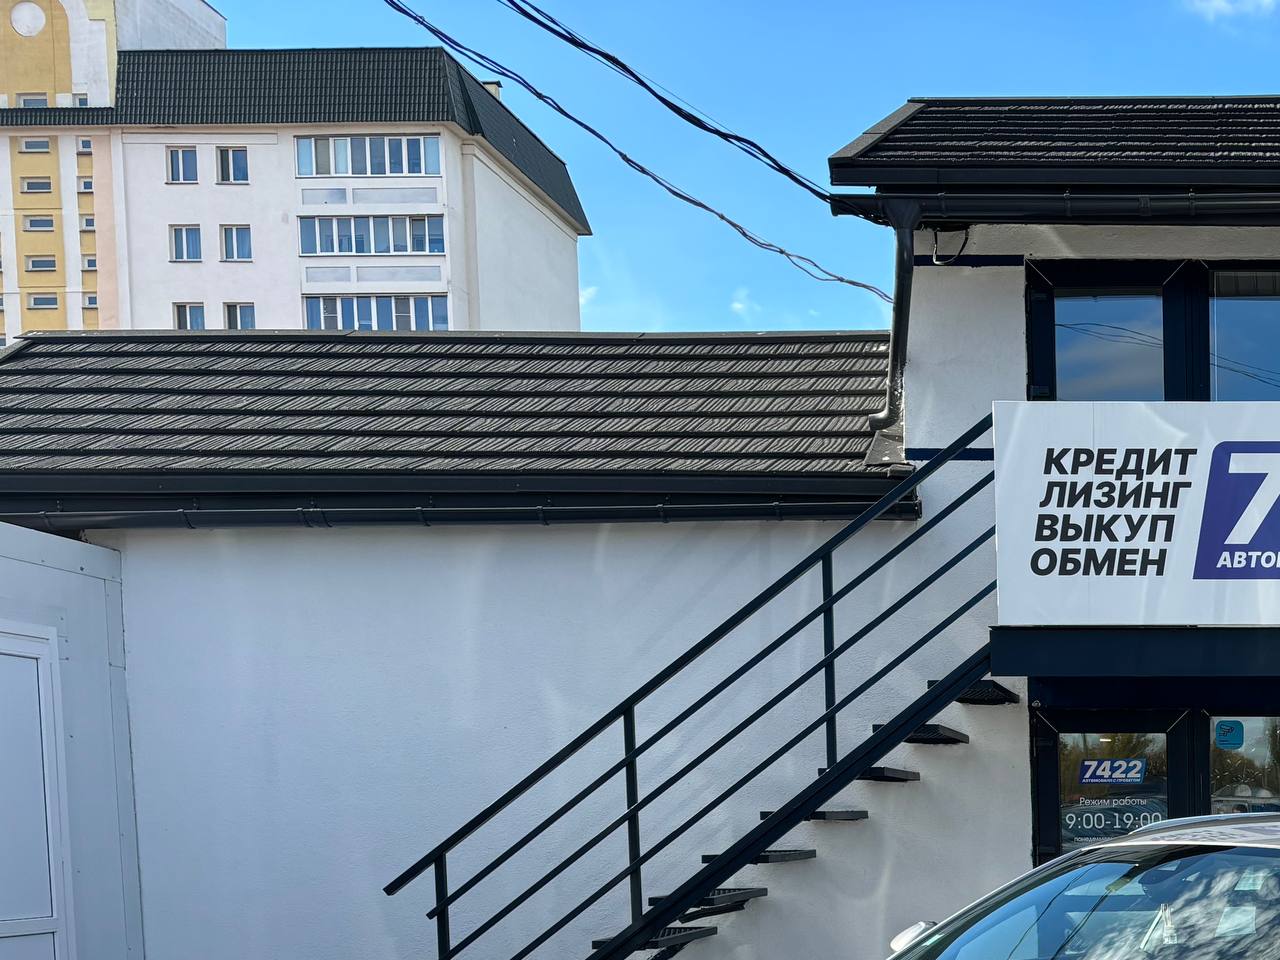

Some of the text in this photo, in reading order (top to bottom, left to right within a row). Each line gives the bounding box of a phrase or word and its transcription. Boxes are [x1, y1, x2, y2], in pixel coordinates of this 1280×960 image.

[1043, 447, 1198, 481] КРЕДИТ
[1039, 480, 1192, 508] ЛИЗИНГ
[1034, 513, 1176, 543] ВЫКУП
[1030, 547, 1168, 577] ОБМЕН
[1084, 760, 1142, 778] 7422
[1079, 796, 1147, 808] Режим работы
